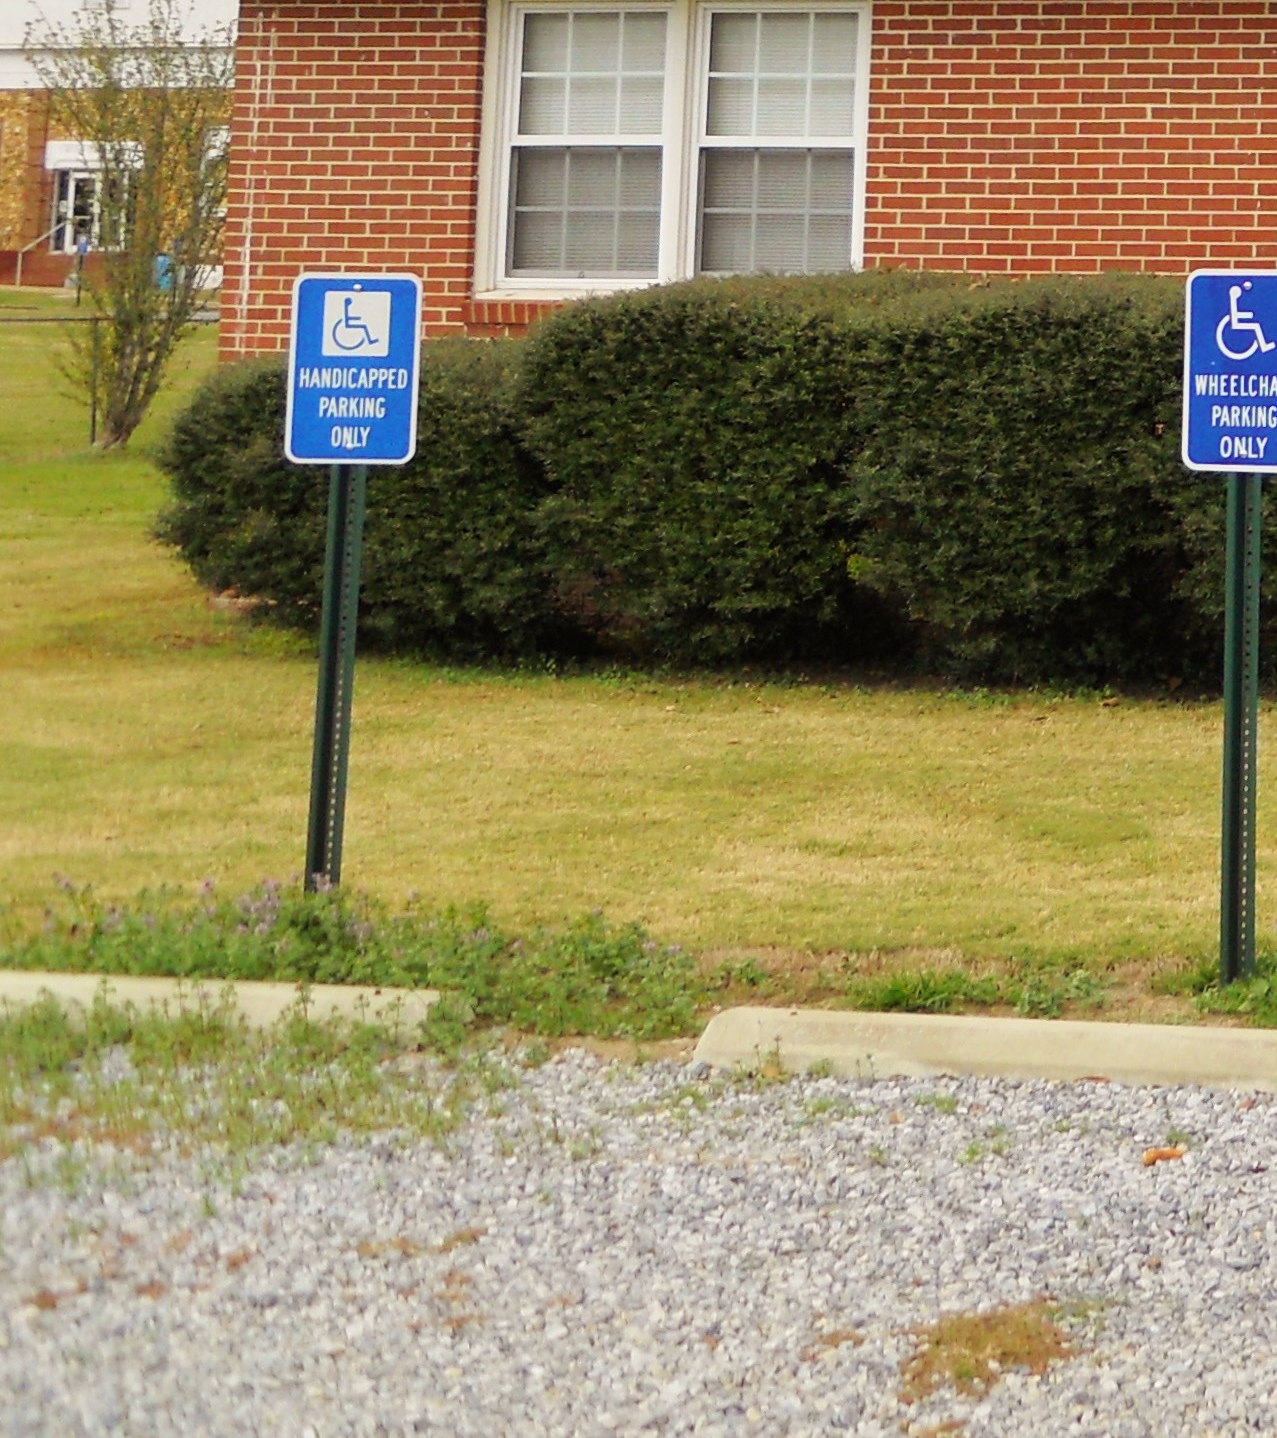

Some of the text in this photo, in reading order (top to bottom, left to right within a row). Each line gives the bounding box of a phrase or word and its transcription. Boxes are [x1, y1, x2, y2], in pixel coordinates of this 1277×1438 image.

[299, 367, 408, 389] HANDICAPPED
[318, 397, 386, 418] PARKING
[1211, 405, 1277, 428] PARKING
[331, 426, 371, 448] ONLY
[1219, 435, 1268, 459] ONLY
